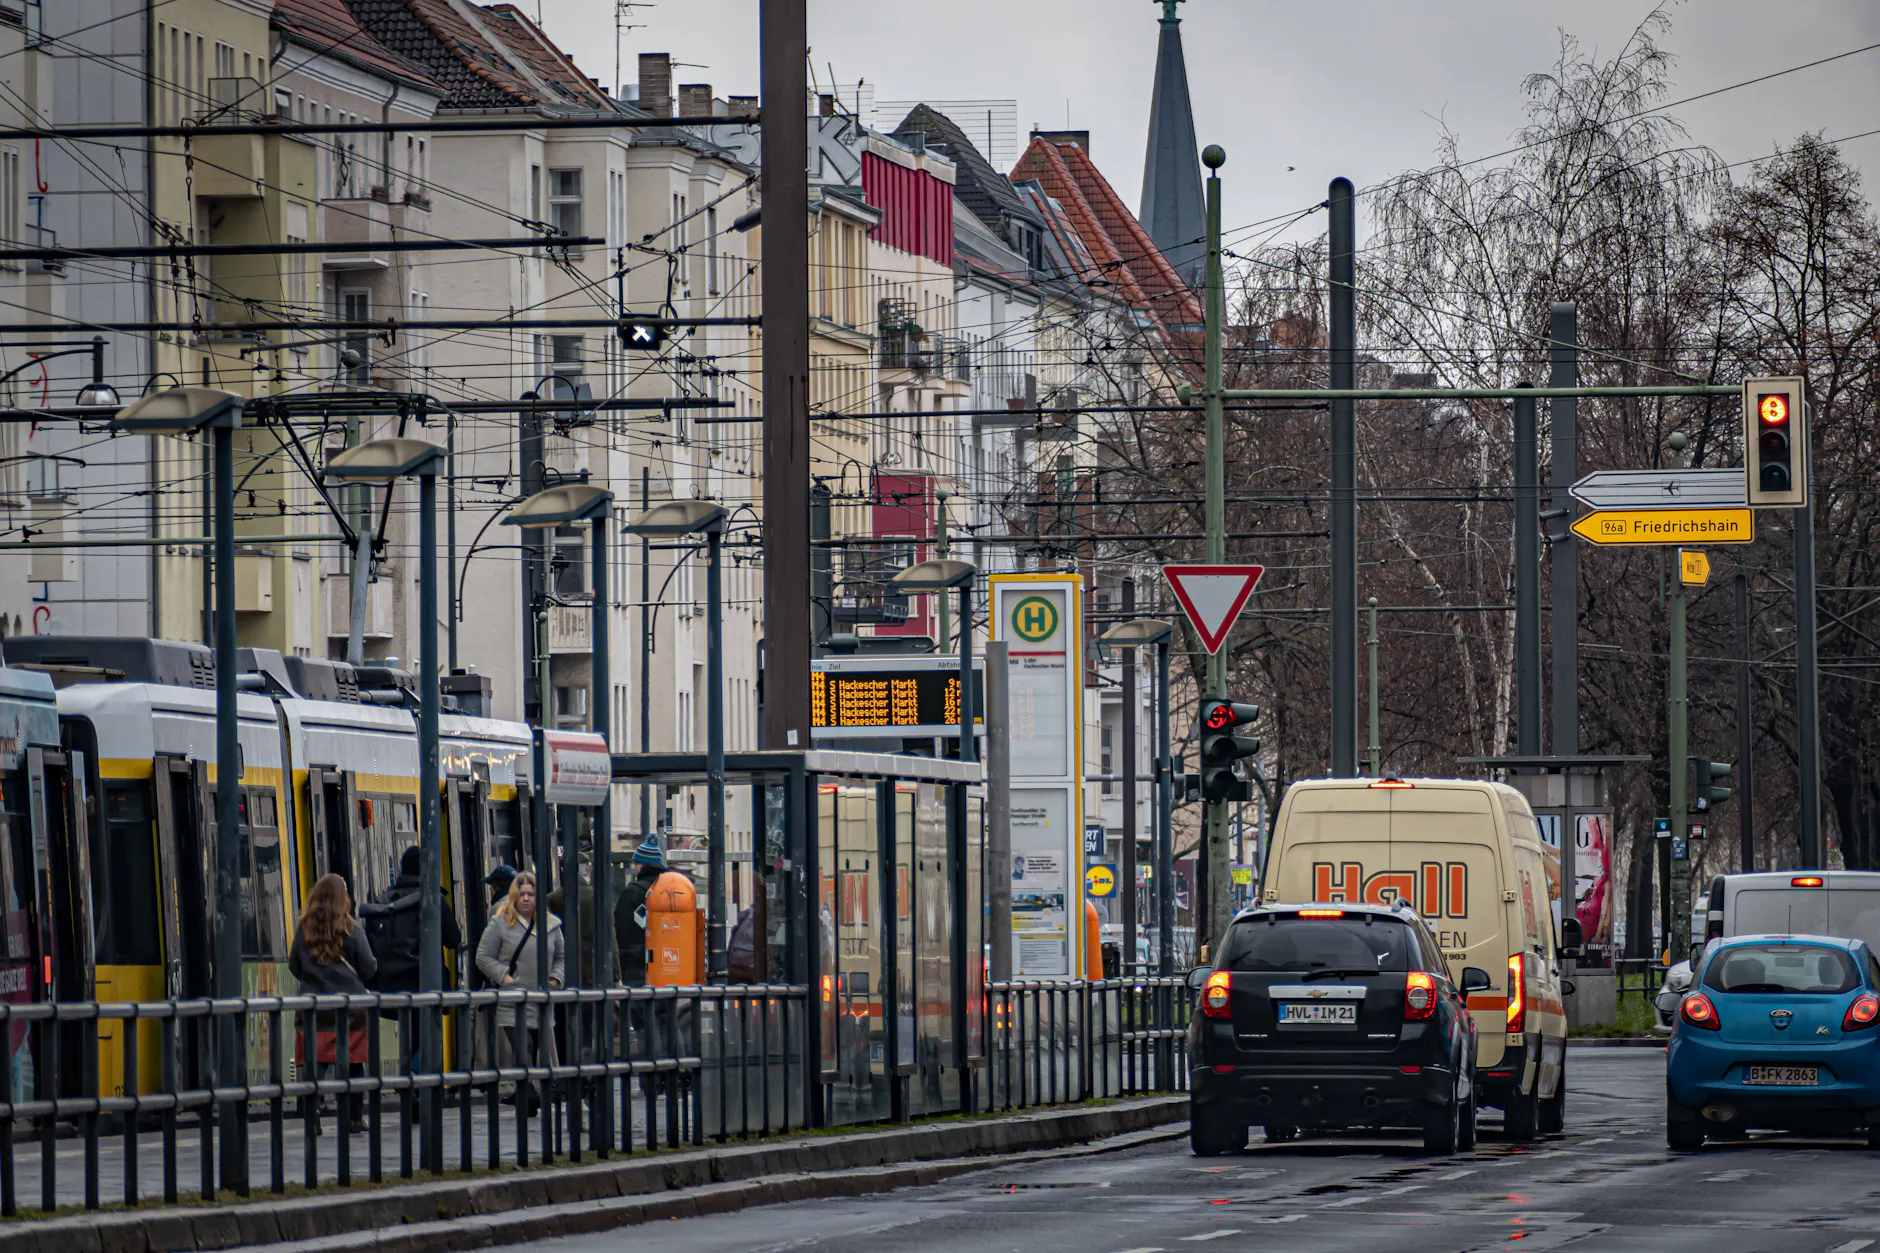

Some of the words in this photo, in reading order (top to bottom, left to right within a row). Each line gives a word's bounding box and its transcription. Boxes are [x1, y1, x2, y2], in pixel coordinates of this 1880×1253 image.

[1605, 522, 1623, 532] 96a
[1634, 519, 1738, 533] Friedrichshain
[1024, 607, 1045, 632] H
[812, 681, 826, 690] M4
[830, 681, 836, 690] S
[839, 680, 888, 690] Hackescher
[891, 679, 918, 689] Markt
[949, 679, 955, 688] 9
[812, 690, 826, 699] M4
[830, 690, 836, 699] S
[839, 690, 888, 699] Hackescher
[891, 689, 918, 698] Markt
[944, 688, 955, 697] 12
[812, 700, 826, 708] M4
[830, 700, 836, 708] S
[839, 699, 888, 708] Hackescher
[891, 698, 918, 707] Markt
[944, 698, 955, 706] 16
[812, 708, 826, 717] M4
[830, 708, 836, 717] S
[839, 708, 888, 717] Hackescher
[891, 707, 918, 716] Markt
[944, 707, 956, 716] 22
[812, 717, 826, 726] M4
[830, 717, 836, 726] S
[839, 717, 888, 726] Hackescher
[891, 716, 918, 725] Markt
[944, 715, 956, 724] 26
[1085, 830, 1098, 840] RT
[1085, 842, 1096, 852] EN
[1312, 862, 1468, 919] Hall
[664, 950, 677, 962] BSR
[1286, 1006, 1311, 1019] HVL
[1320, 1007, 1337, 1019] IM
[1338, 1007, 1355, 1019] 21
[1752, 1068, 1759, 1080] B
[1767, 1069, 1783, 1080] FK
[1786, 1069, 1816, 1080] 2863
